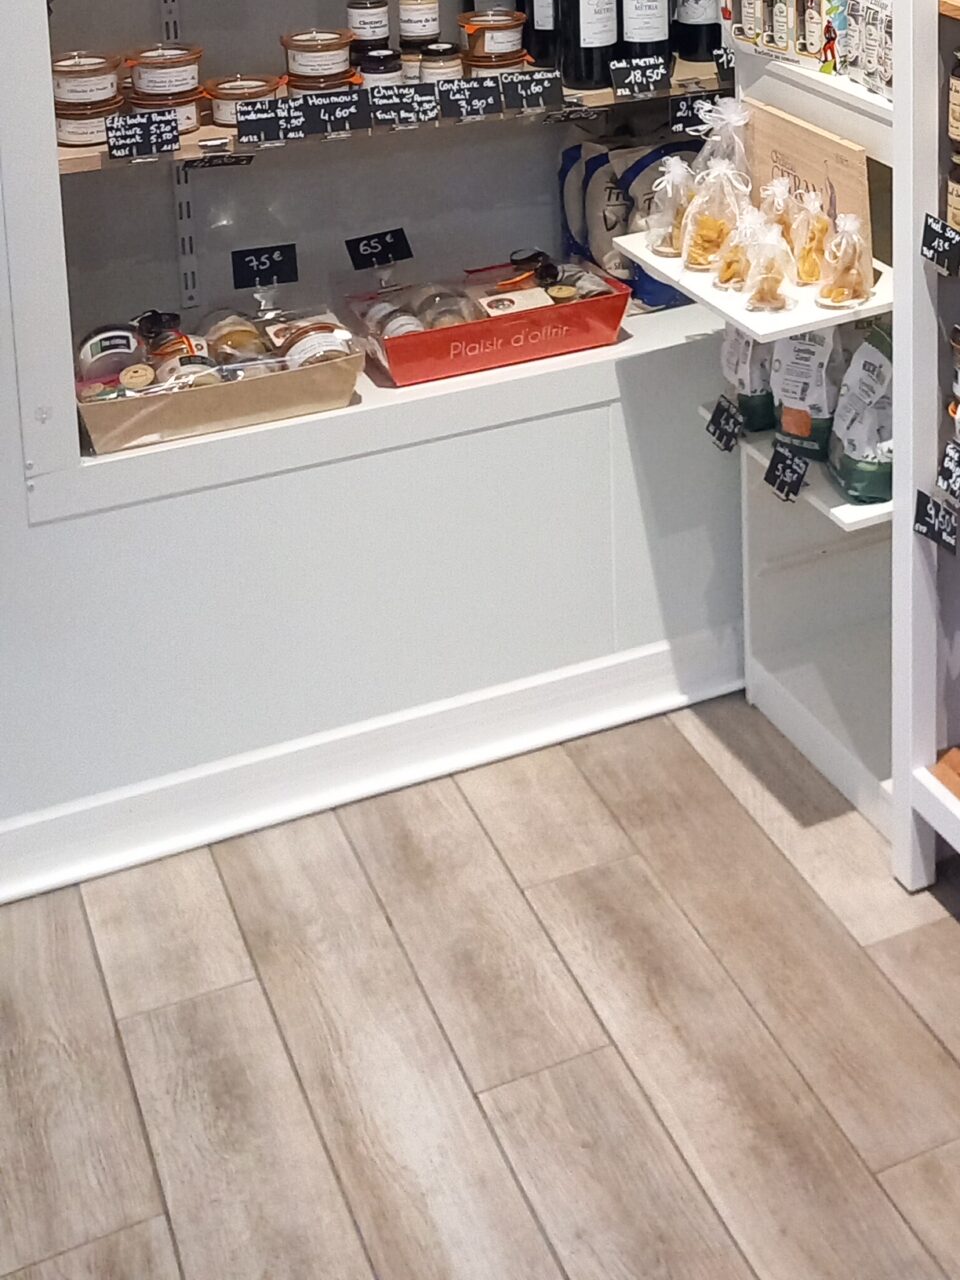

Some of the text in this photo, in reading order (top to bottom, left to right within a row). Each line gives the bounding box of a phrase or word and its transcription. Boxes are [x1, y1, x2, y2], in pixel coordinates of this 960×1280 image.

[307, 92, 360, 106] Houmous
[358, 233, 395, 256] 65€
[245, 250, 283, 272] 75€
